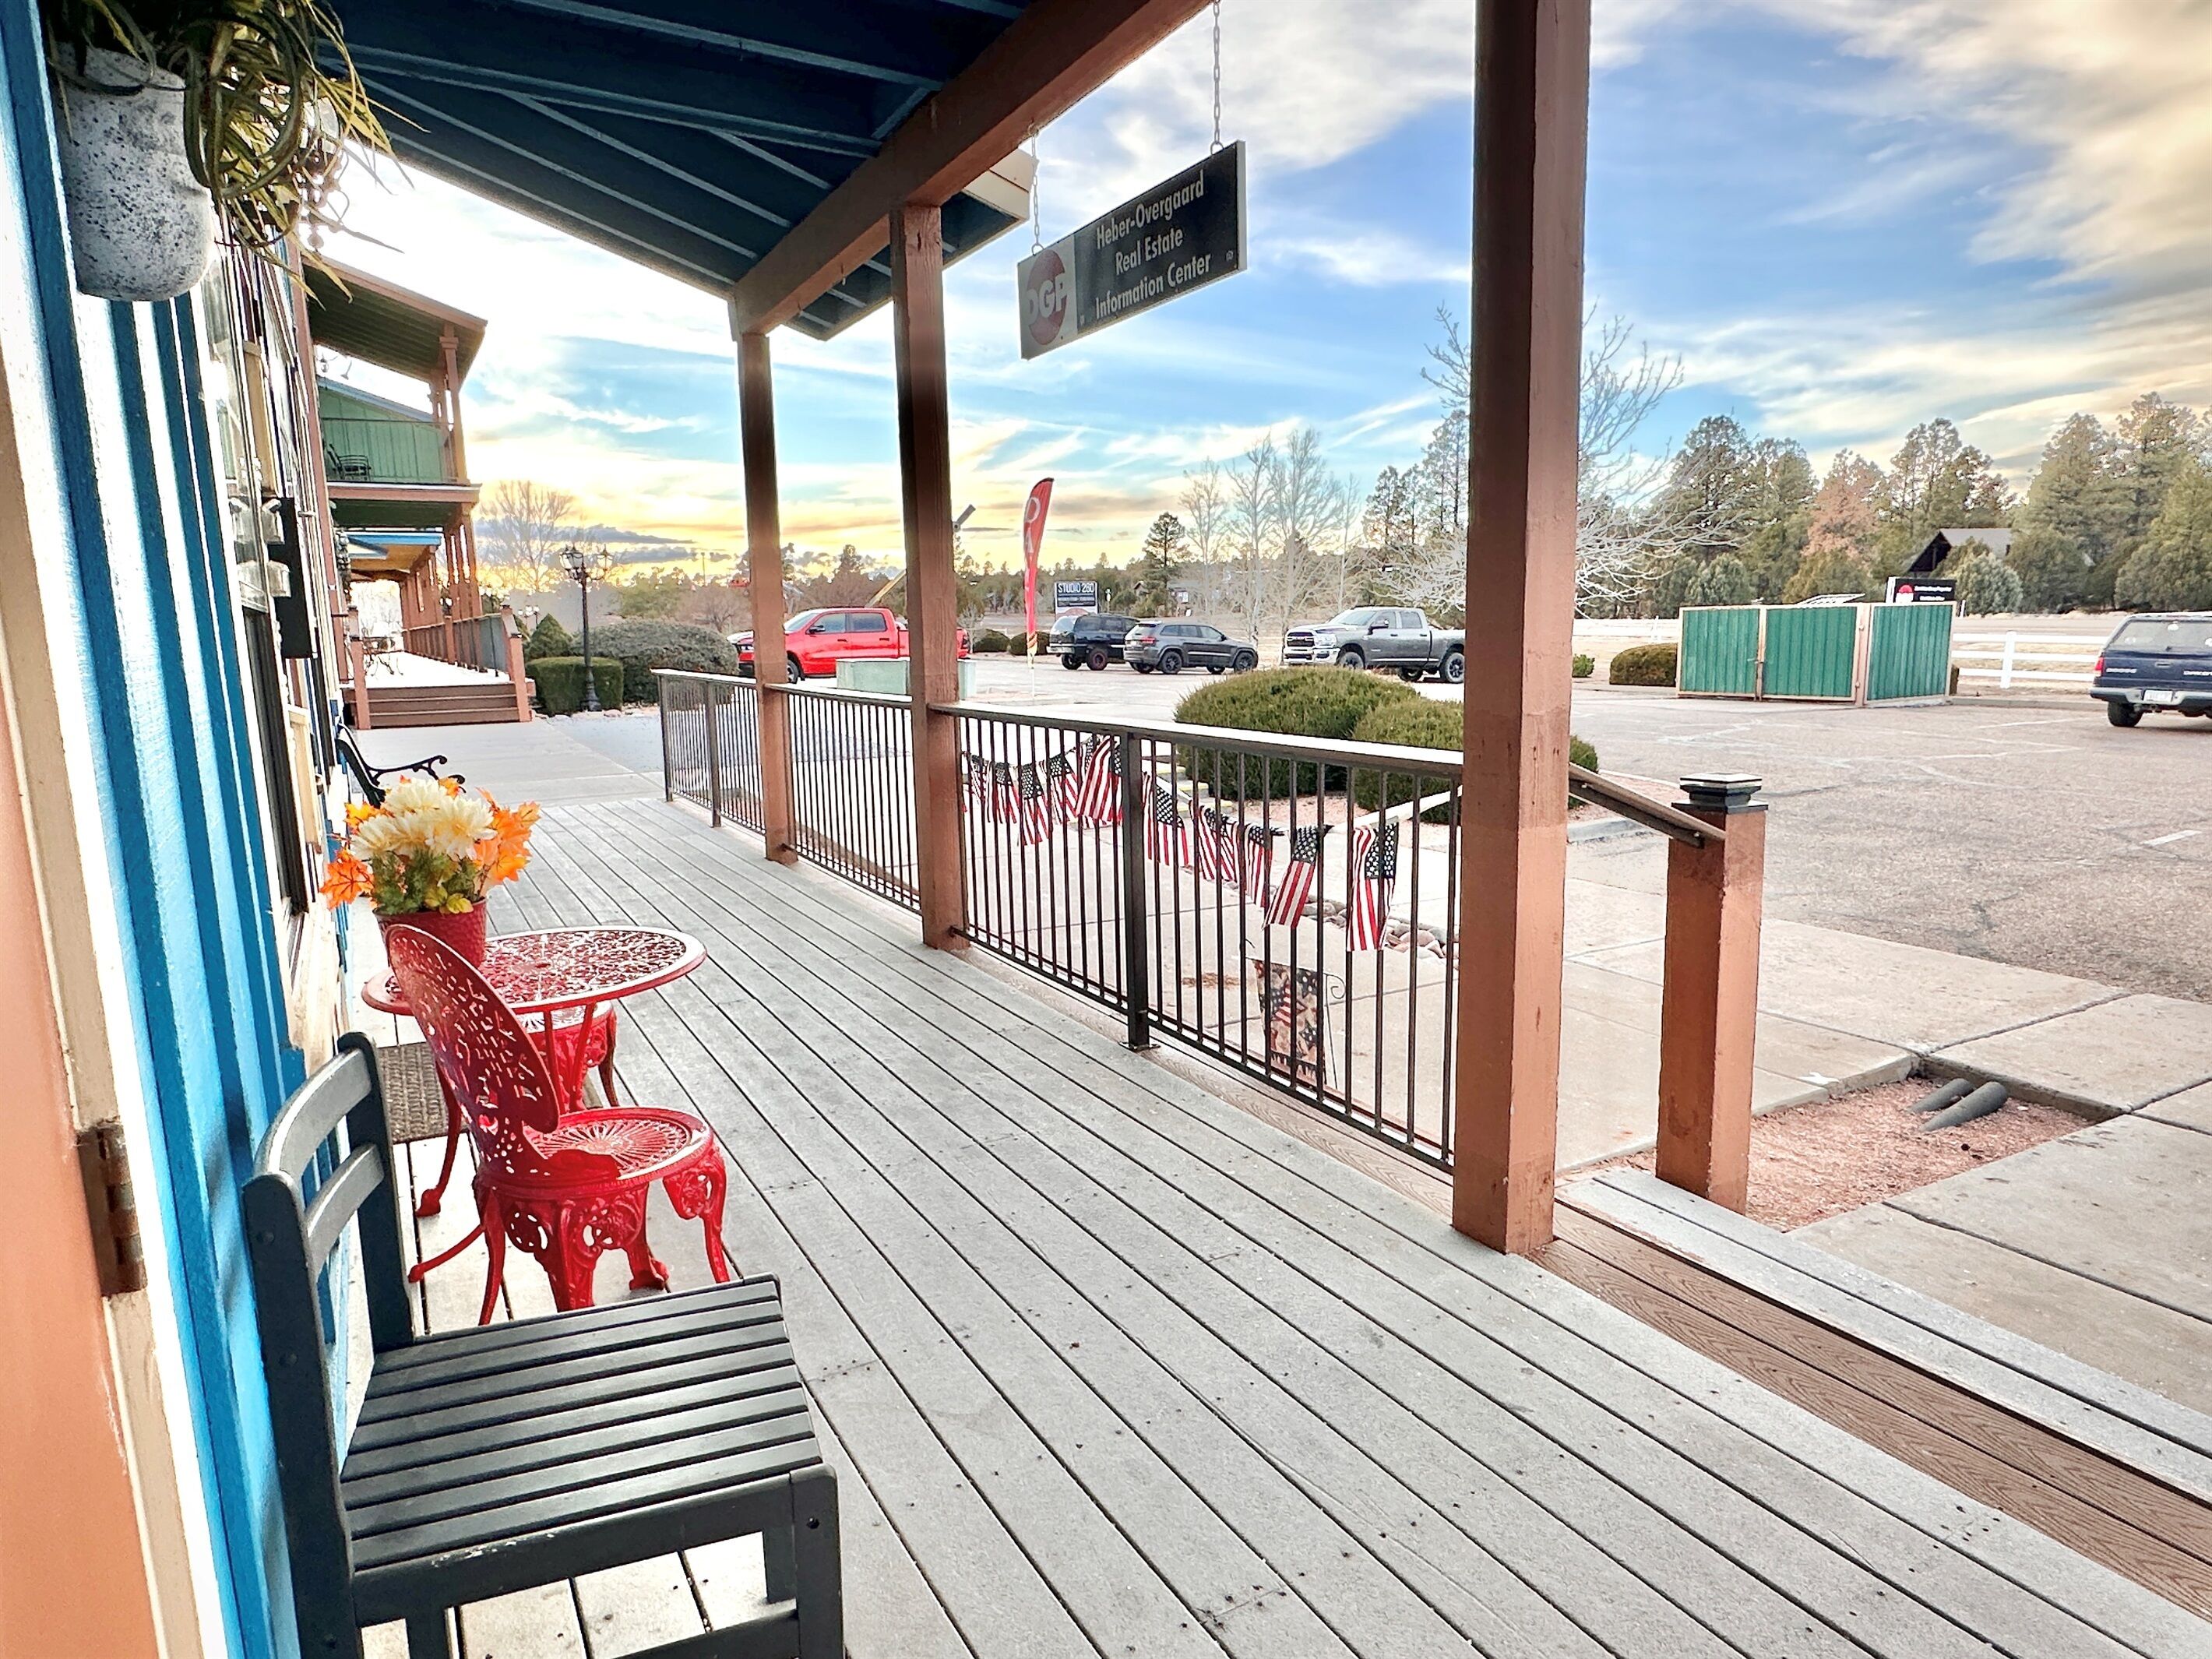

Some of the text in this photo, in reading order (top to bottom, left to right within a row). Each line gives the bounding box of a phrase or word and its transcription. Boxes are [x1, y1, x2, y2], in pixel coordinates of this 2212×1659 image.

[1097, 169, 1203, 249] Heber-Overgaard
[1115, 227, 1183, 275] Real Estate
[1096, 254, 1210, 319] Information Center
